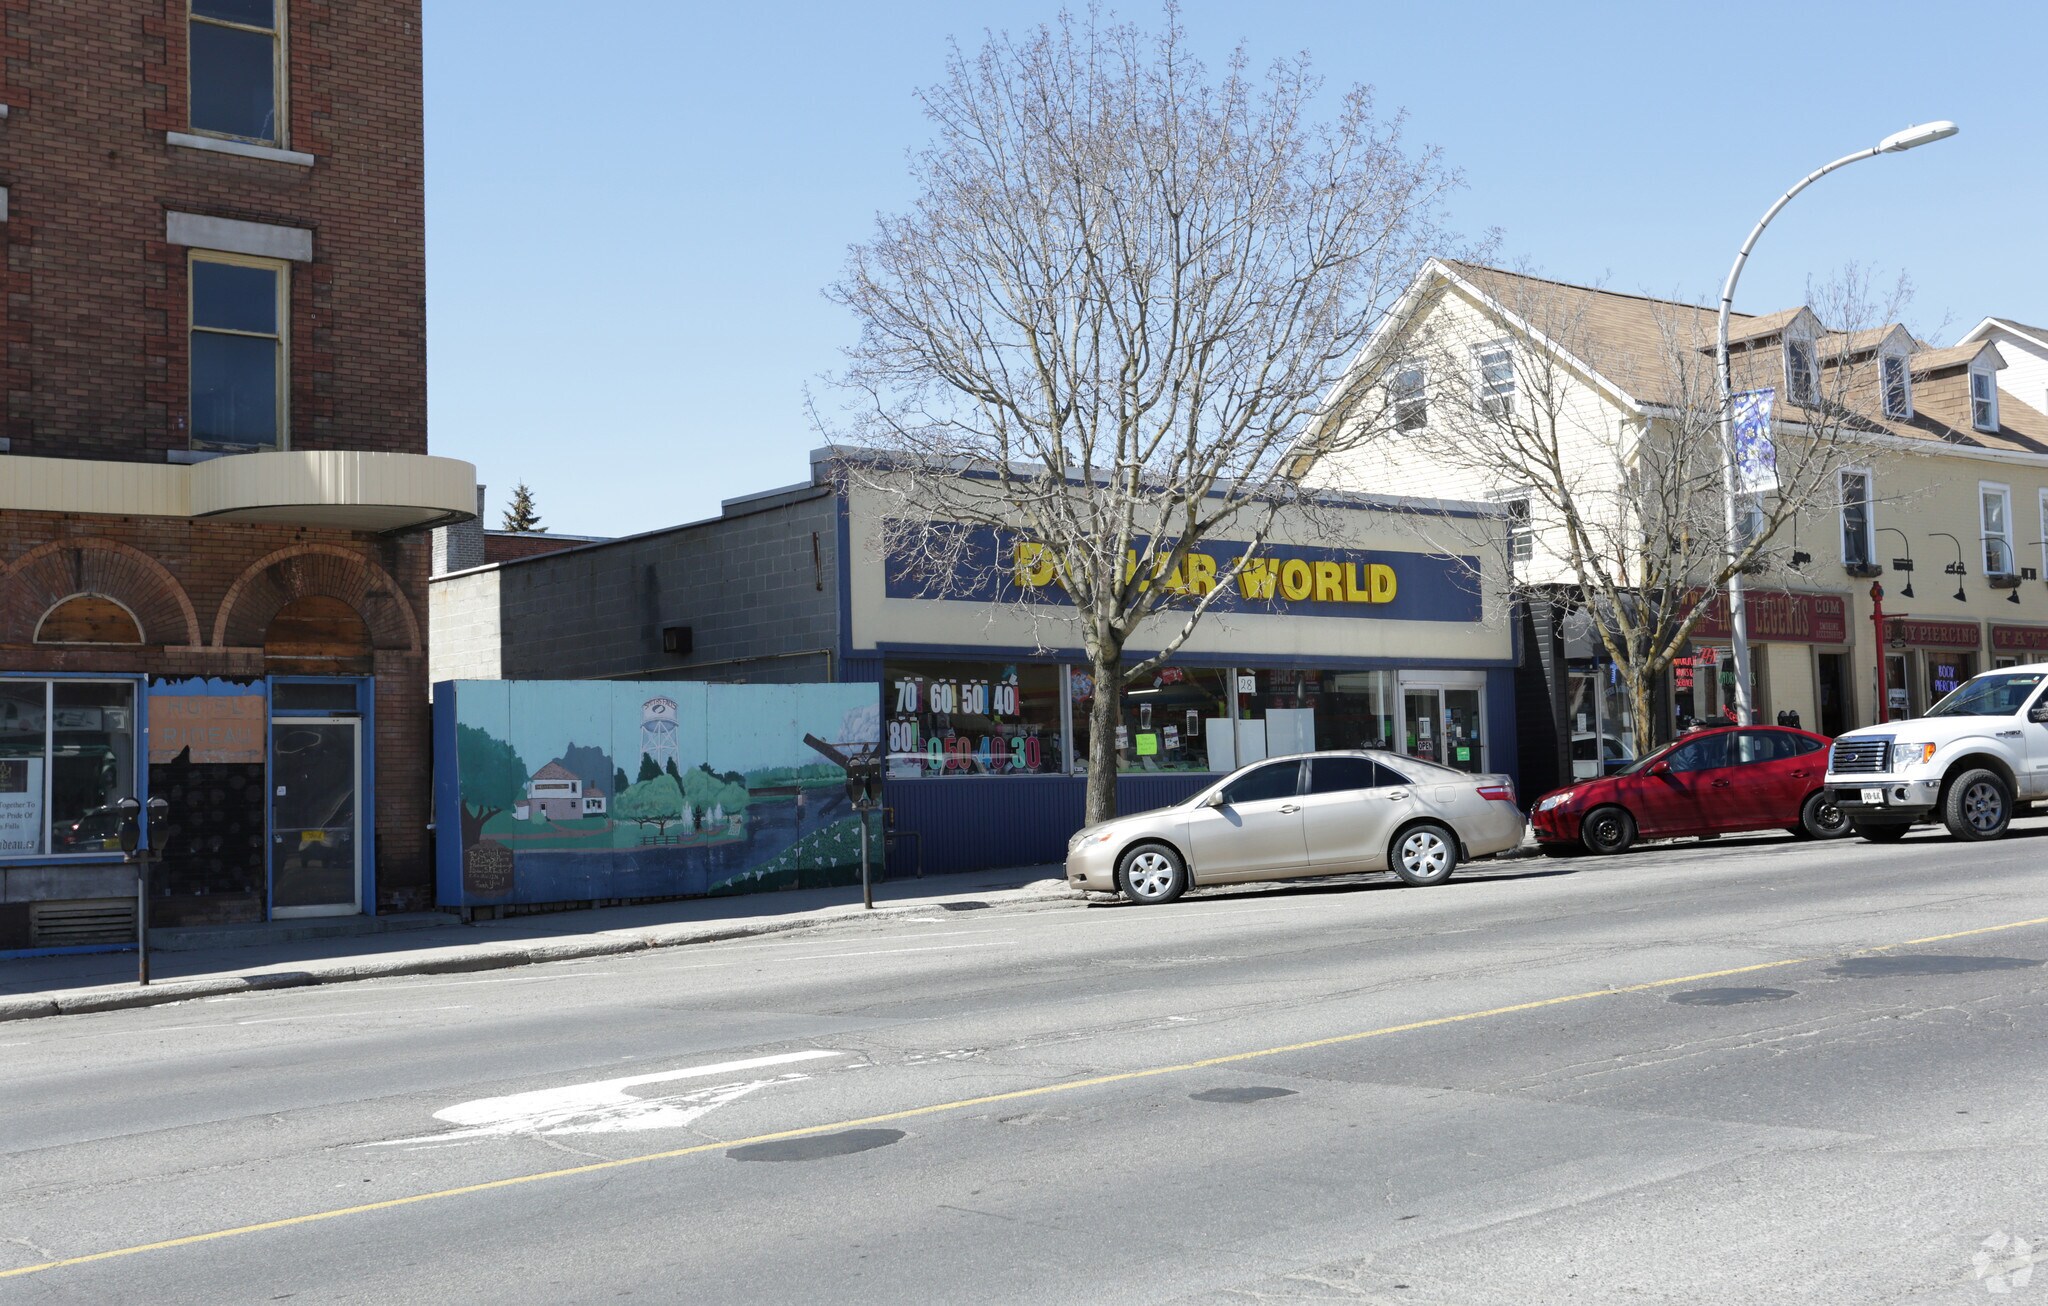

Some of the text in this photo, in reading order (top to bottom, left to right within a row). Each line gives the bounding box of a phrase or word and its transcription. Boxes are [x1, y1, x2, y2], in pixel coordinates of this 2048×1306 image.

[1015, 542, 1397, 603] DLAR WORLD
[1814, 600, 1840, 614] COM
[1755, 595, 1809, 637] LEGENDS
[1885, 623, 1978, 644] BDY PIERCING
[1938, 665, 1955, 678] BODY
[1241, 678, 1252, 691] 28
[163, 727, 252, 744] RIDEAU
[944, 737, 971, 769] 50
[978, 737, 1005, 769] 40
[1011, 737, 1040, 769] 30
[1418, 741, 1433, 751] OPEN
[0, 801, 25, 810] Together
[0, 840, 35, 850] deau.ca
